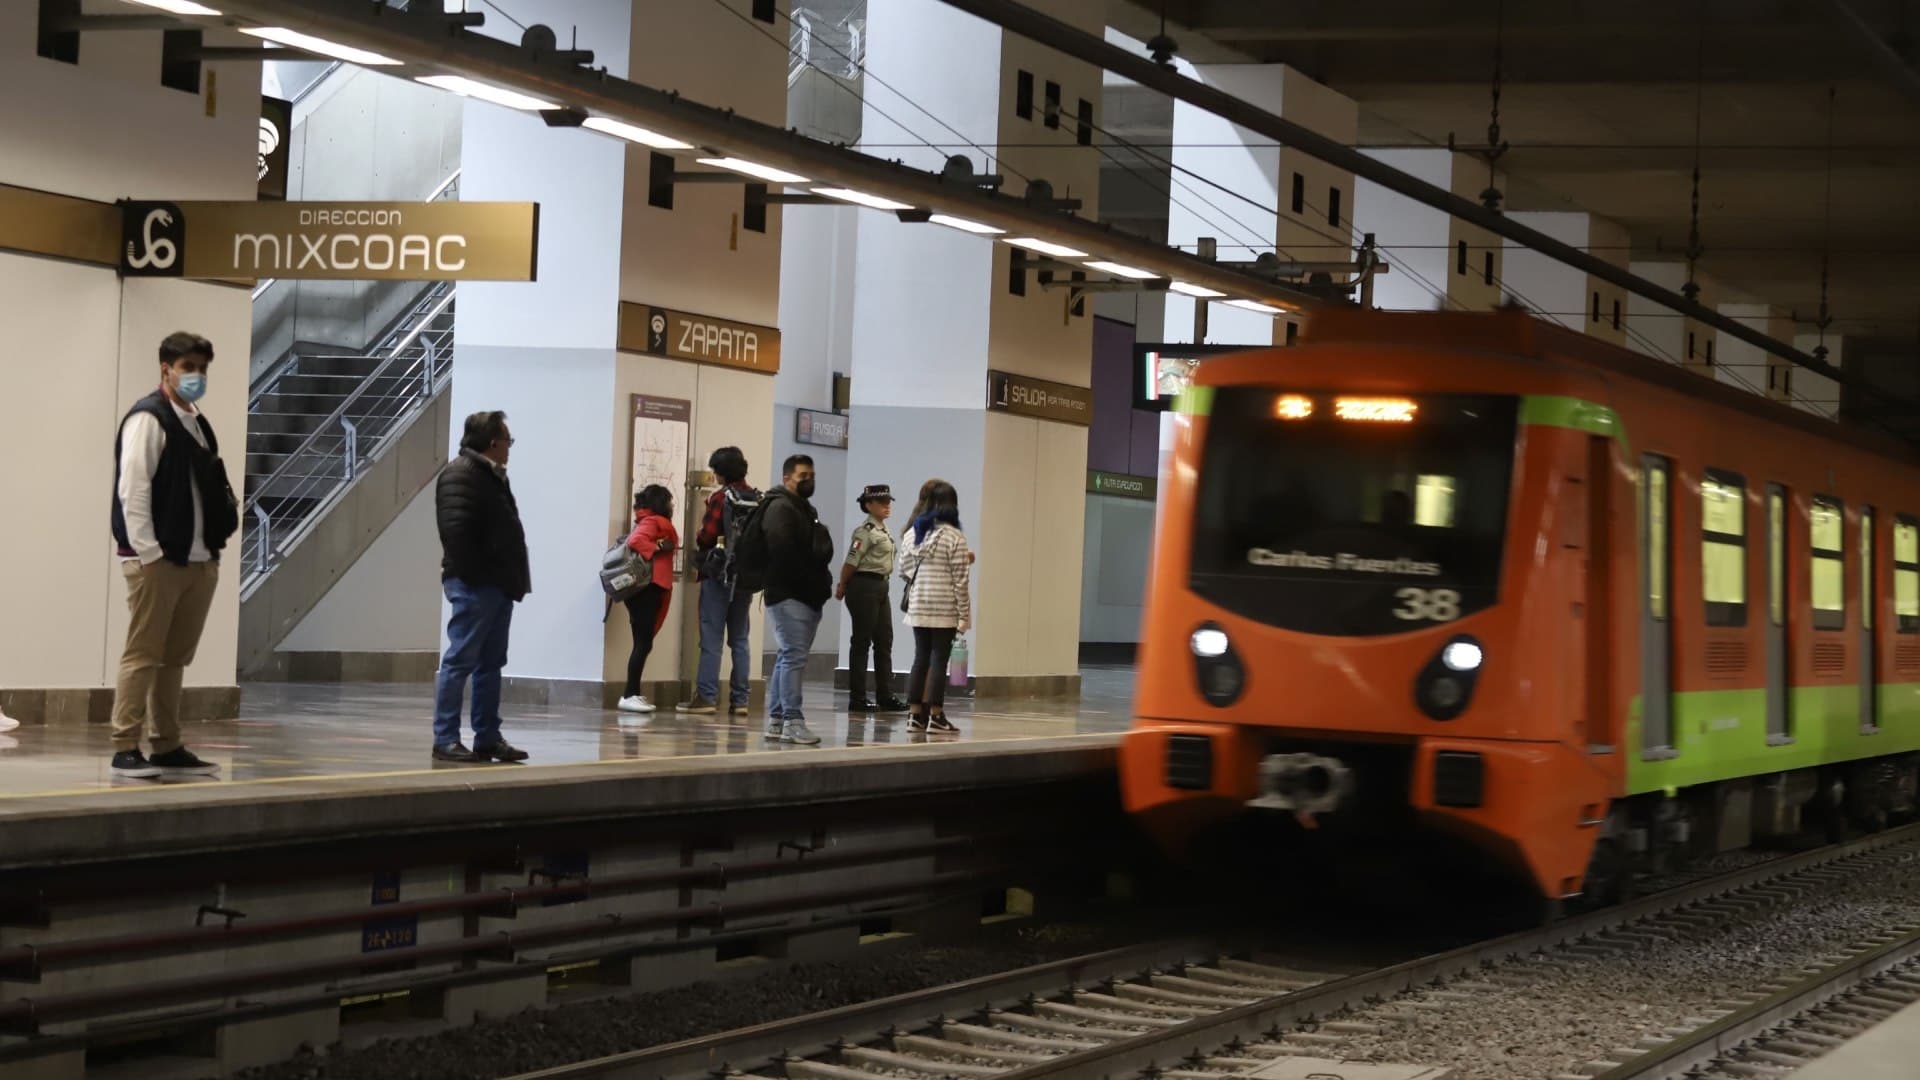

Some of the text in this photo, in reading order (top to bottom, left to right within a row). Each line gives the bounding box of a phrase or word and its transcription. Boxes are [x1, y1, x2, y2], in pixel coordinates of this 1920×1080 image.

[299, 209, 402, 226] DIRECCION
[234, 234, 467, 271] MIXCOAC
[678, 320, 758, 364] ZAPATA
[1012, 385, 1047, 407] SALIDA
[1247, 547, 1335, 570] Carlos
[1392, 586, 1462, 621] 38
